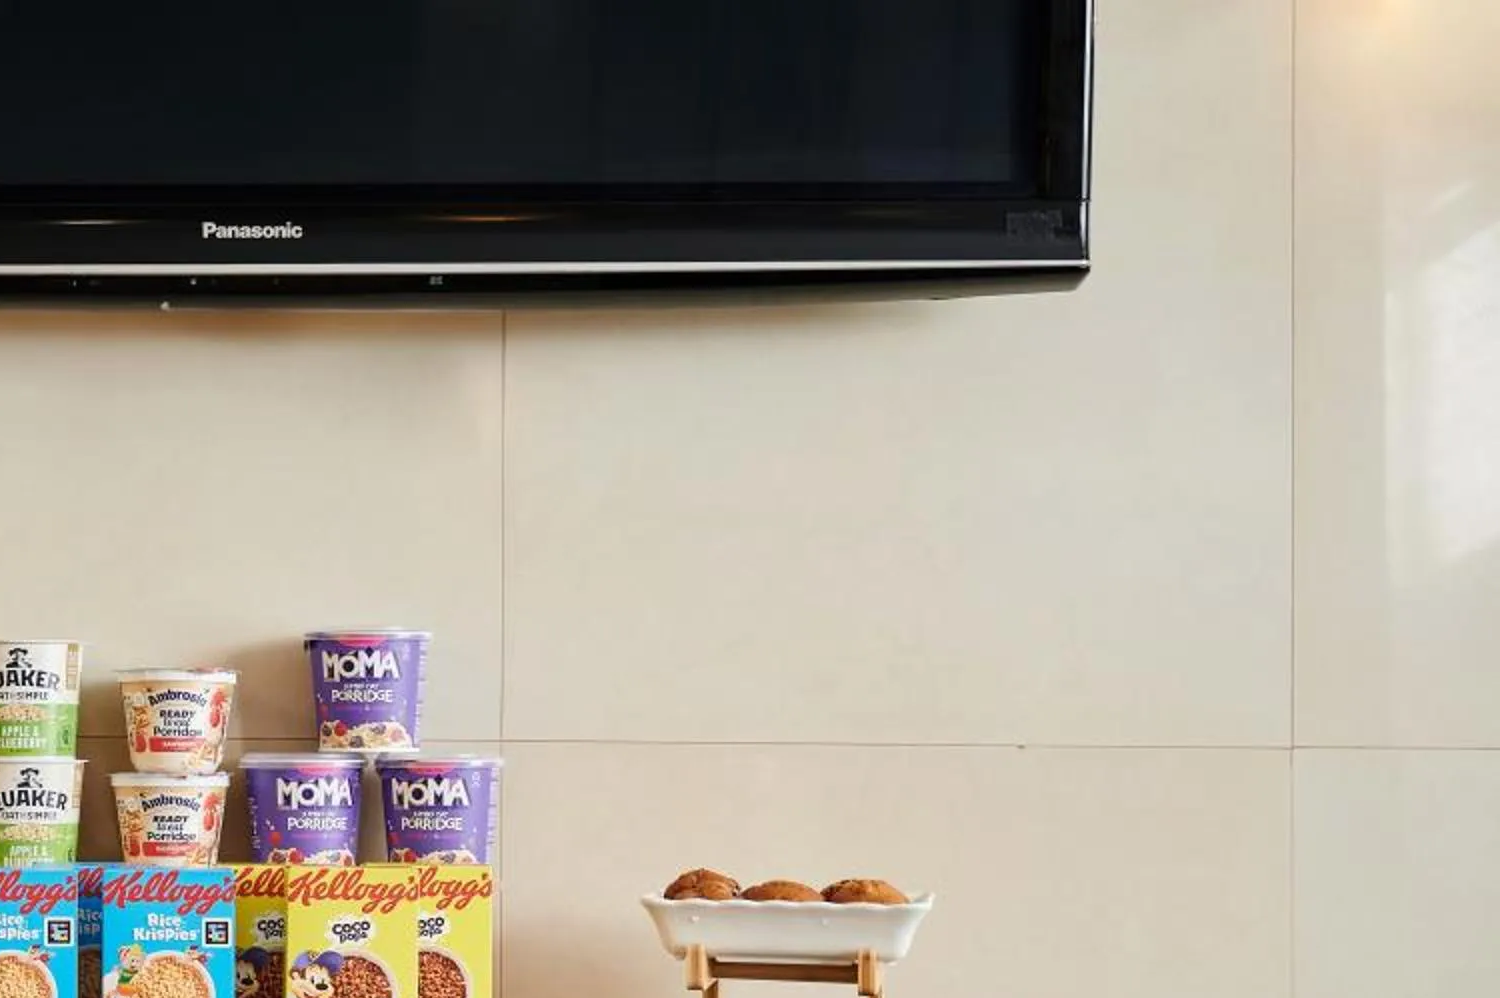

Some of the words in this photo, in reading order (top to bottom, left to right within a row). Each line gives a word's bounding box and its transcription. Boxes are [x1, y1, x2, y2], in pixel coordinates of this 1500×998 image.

[201, 221, 303, 239] Panasonic
[331, 690, 395, 703] PORRIDGE
[159, 709, 196, 718] READY
[287, 816, 348, 831] PORRIDGE
[401, 817, 463, 831] PORRIDGE
[103, 869, 237, 915] Kellogg's
[287, 868, 419, 913] Kellogg's
[147, 913, 182, 927] Rice
